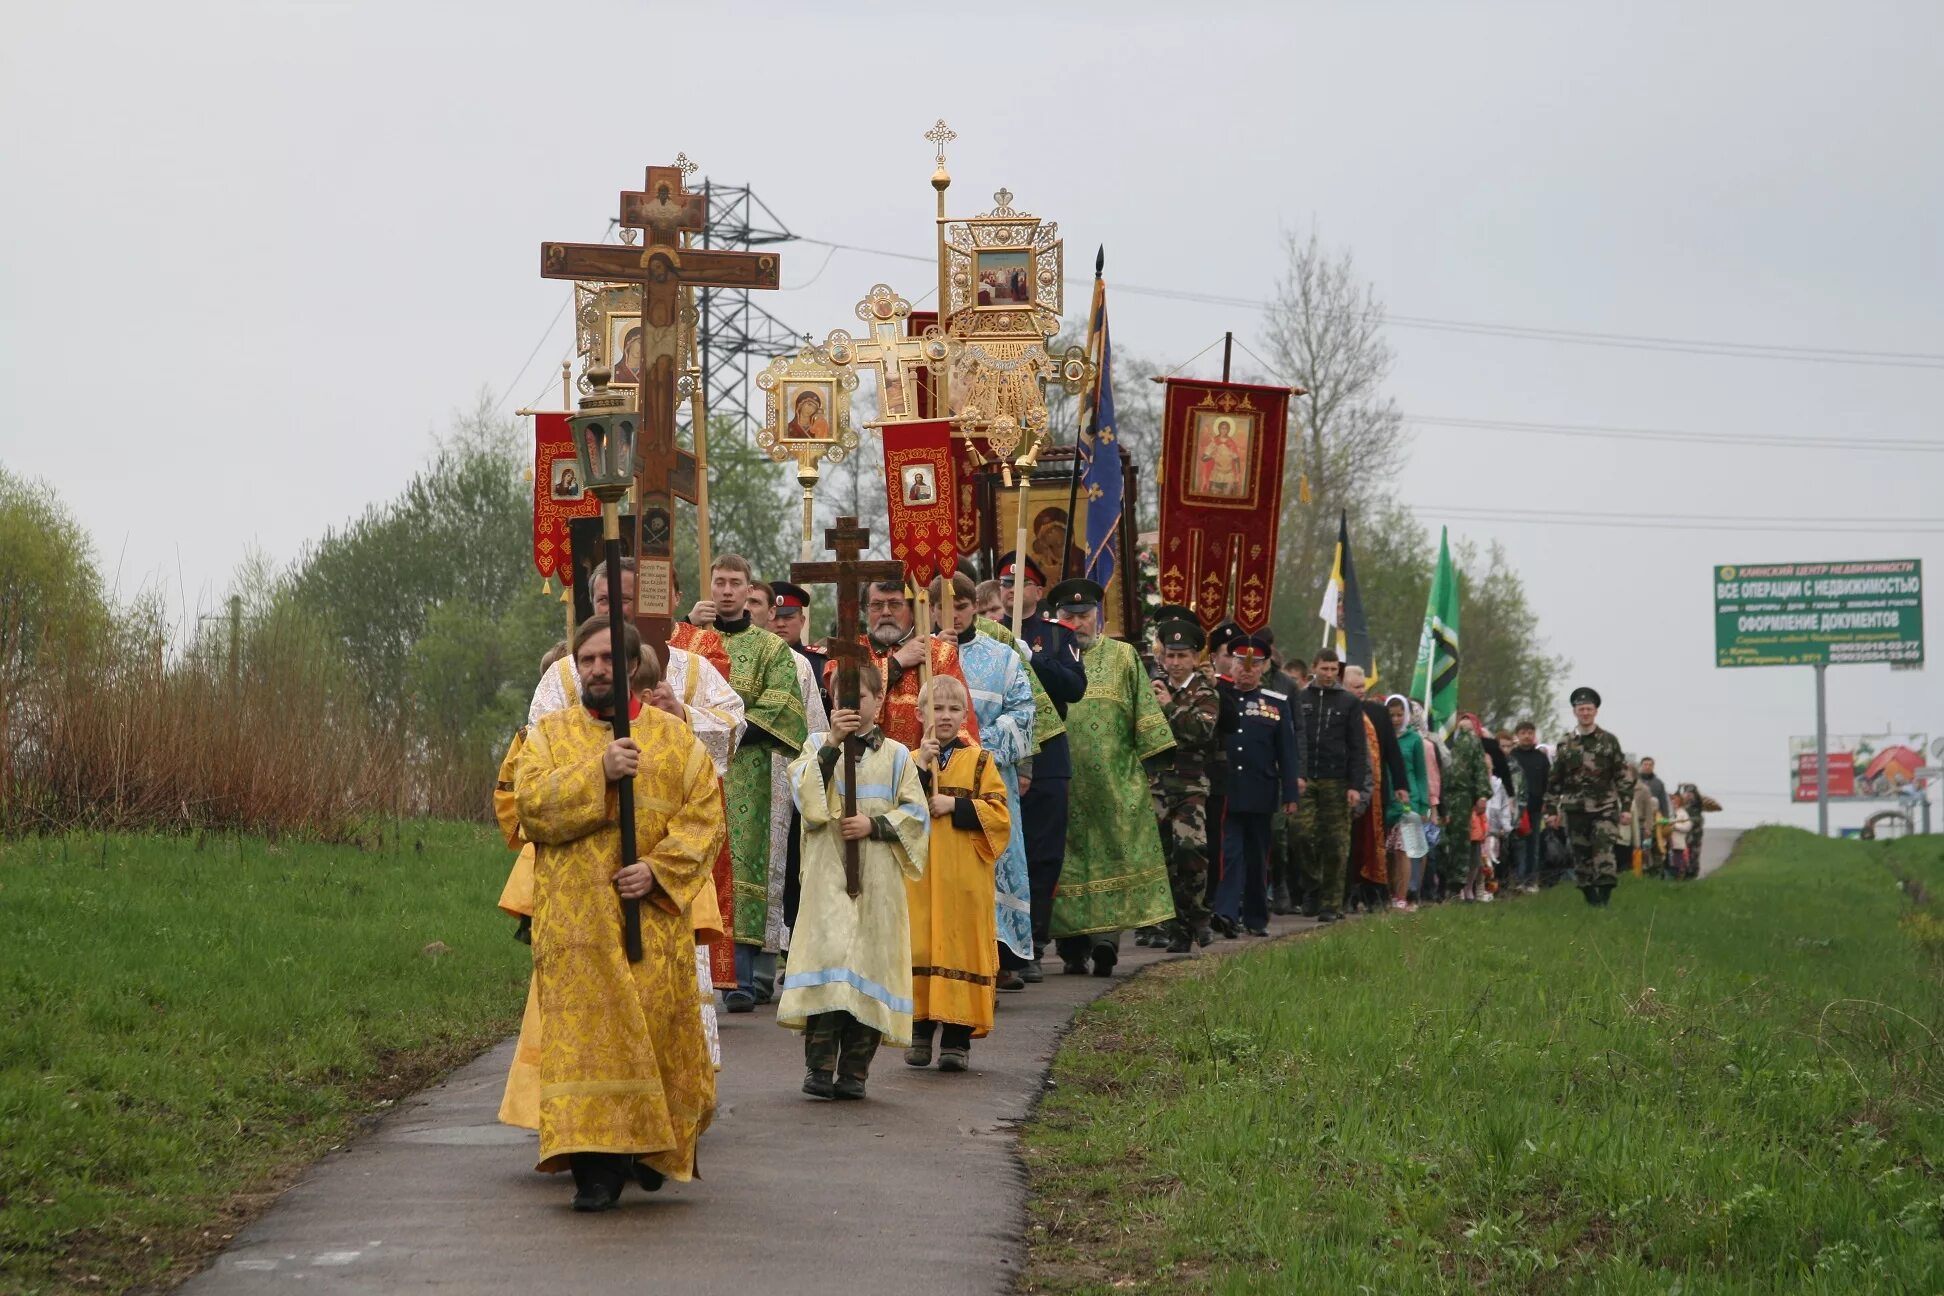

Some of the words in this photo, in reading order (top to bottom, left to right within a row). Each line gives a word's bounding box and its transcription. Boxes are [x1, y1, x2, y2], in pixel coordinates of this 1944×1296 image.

[1717, 582, 1739, 599] ВСЕ
[1741, 581, 1801, 599] ОПЕРАЦИИ
[1803, 580, 1812, 596] С
[1814, 576, 1919, 598] НЕДВИЖИМОСТЬЮ
[1738, 614, 1818, 632] ОФОРМЛЕНИЕ
[1820, 611, 1900, 632] ДОКУМЕНТОВ
